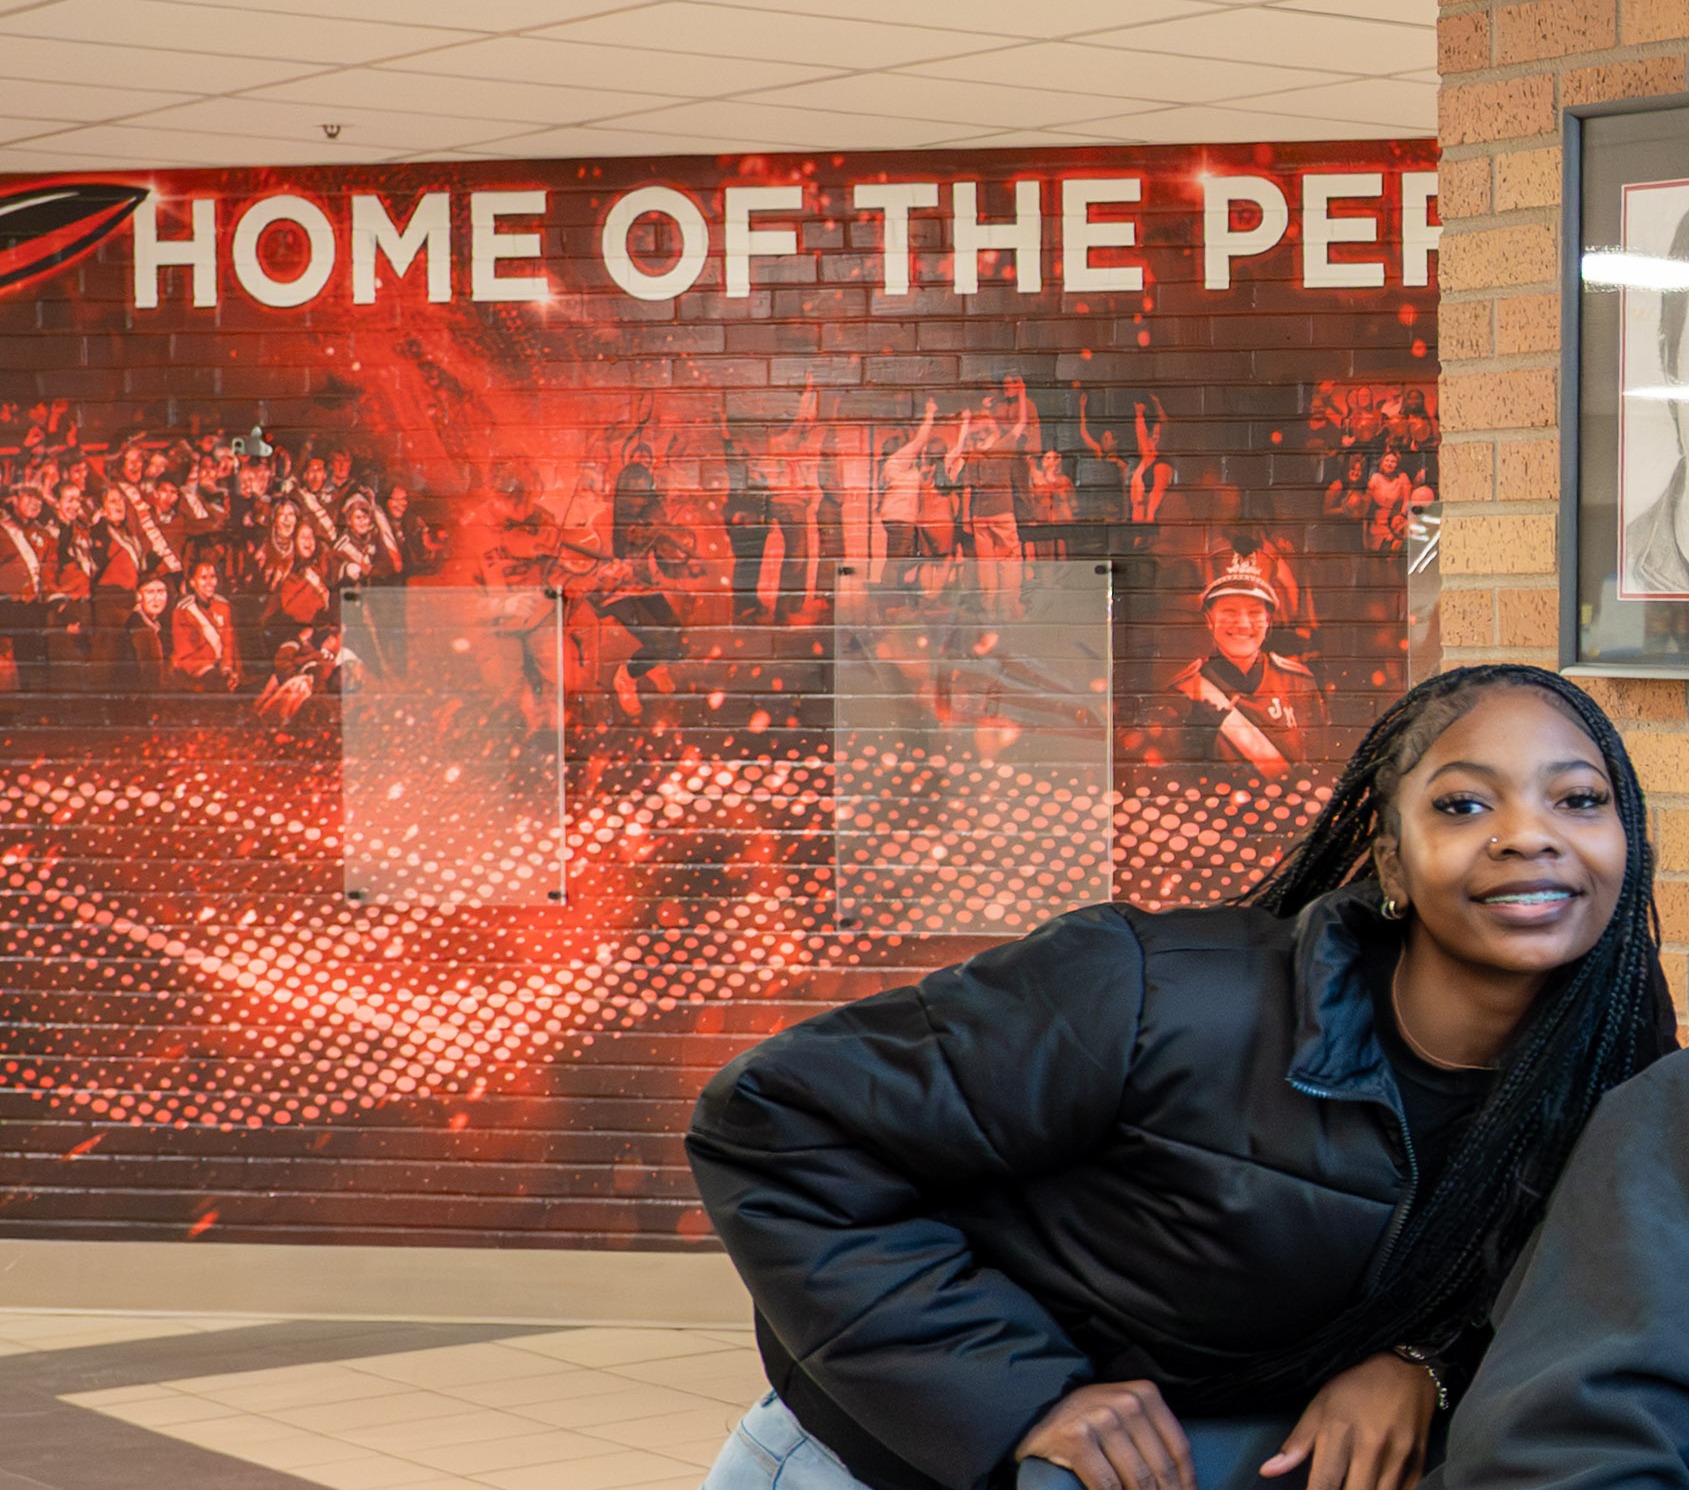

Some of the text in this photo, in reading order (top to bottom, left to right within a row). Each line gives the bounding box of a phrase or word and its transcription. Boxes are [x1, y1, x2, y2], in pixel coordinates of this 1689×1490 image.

[133, 190, 550, 309] HOME
[600, 185, 803, 302] OF
[852, 179, 1144, 296] THE
